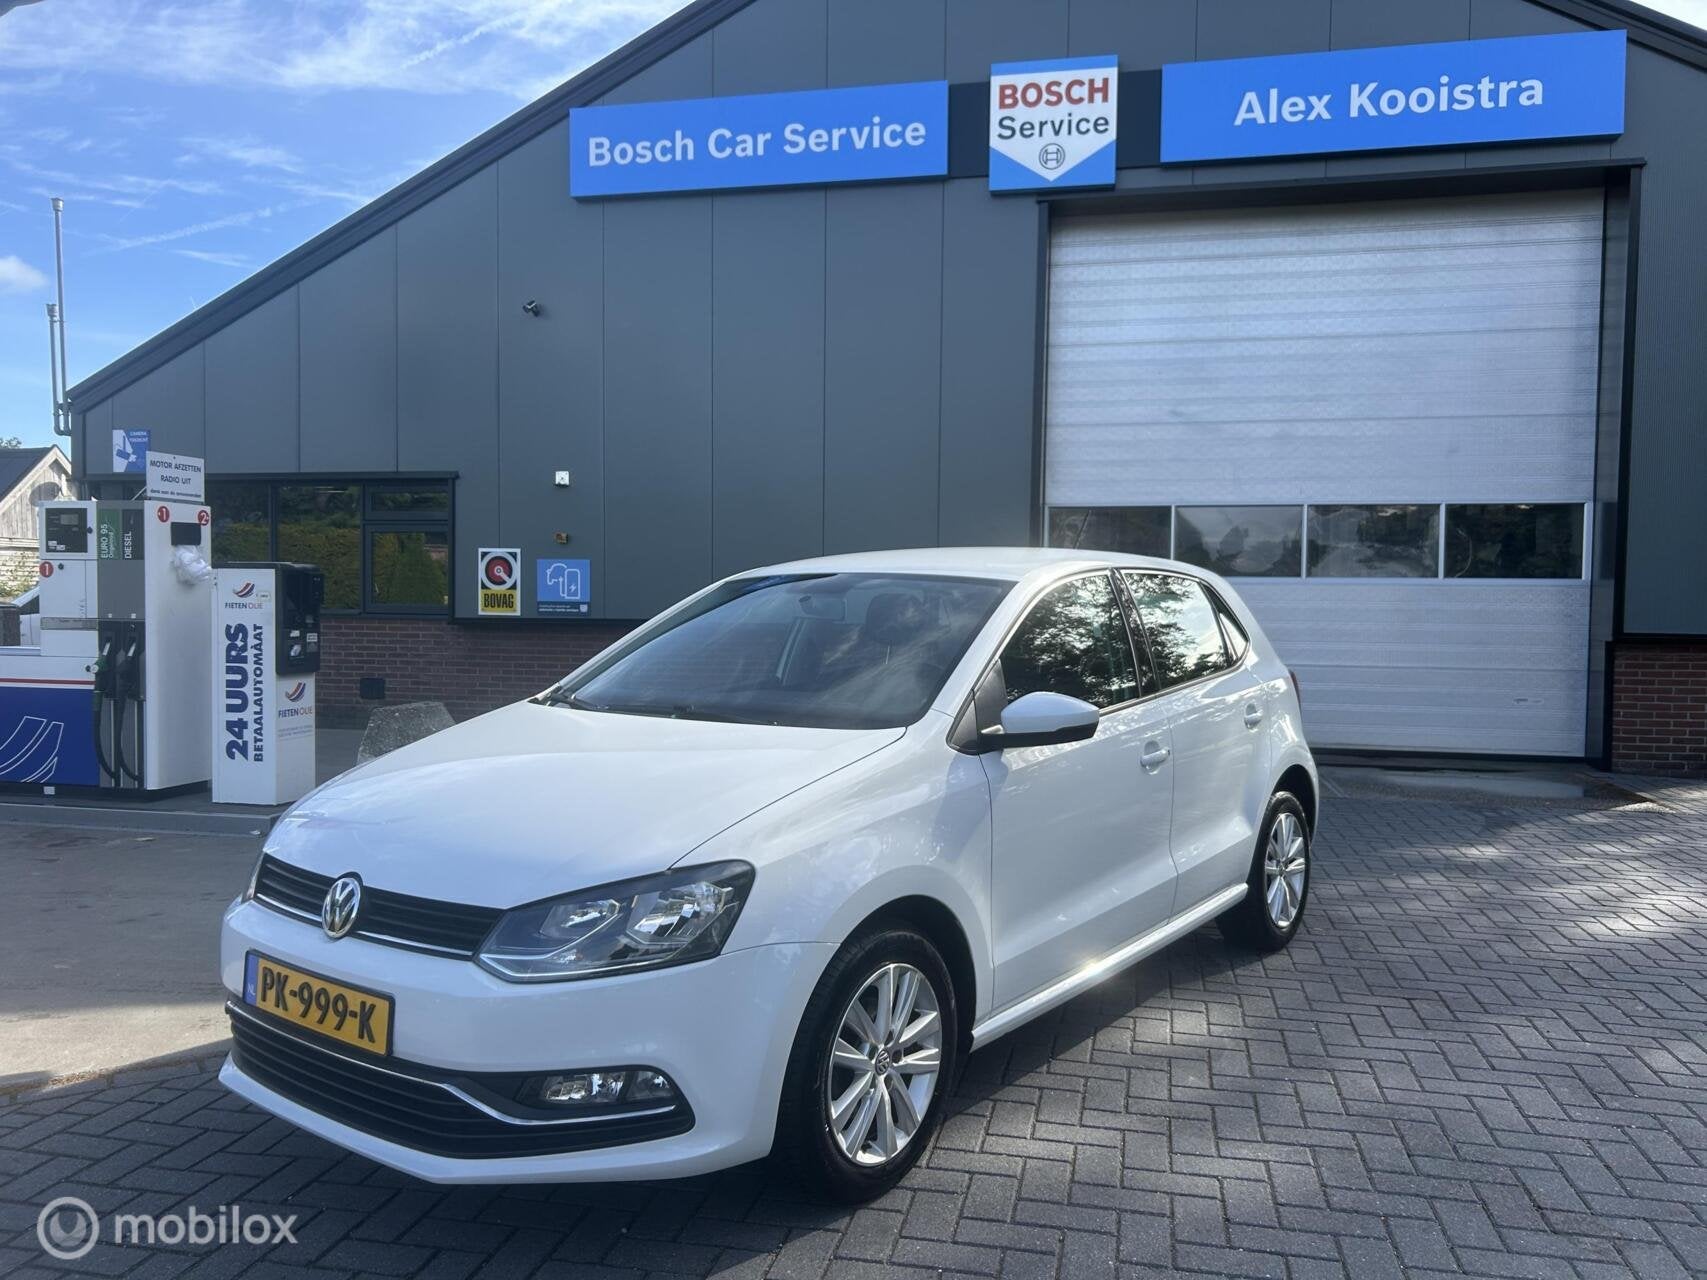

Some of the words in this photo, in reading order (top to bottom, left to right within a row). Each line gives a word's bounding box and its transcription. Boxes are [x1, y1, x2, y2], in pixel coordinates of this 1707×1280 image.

[998, 77, 1109, 110] BOSCH
[1233, 88, 1332, 126] Alex
[1349, 74, 1544, 118] Kooistra
[997, 113, 1109, 140] Service
[588, 130, 694, 167] Bosch
[707, 127, 771, 159] Car
[783, 116, 926, 155] Service
[150, 460, 173, 470] MOTOR
[174, 463, 202, 473] AFZETTEN
[160, 475, 180, 484] RADIO
[181, 477, 192, 485] UIT
[100, 524, 109, 534] 95
[100, 537, 109, 558] EURO
[124, 531, 132, 558] DIESEL
[483, 593, 514, 609] BOVAG
[225, 623, 249, 713] UURS
[278, 708, 299, 718] FIETEN
[225, 718, 249, 762] 24
[261, 966, 376, 1044] PK-999-K
